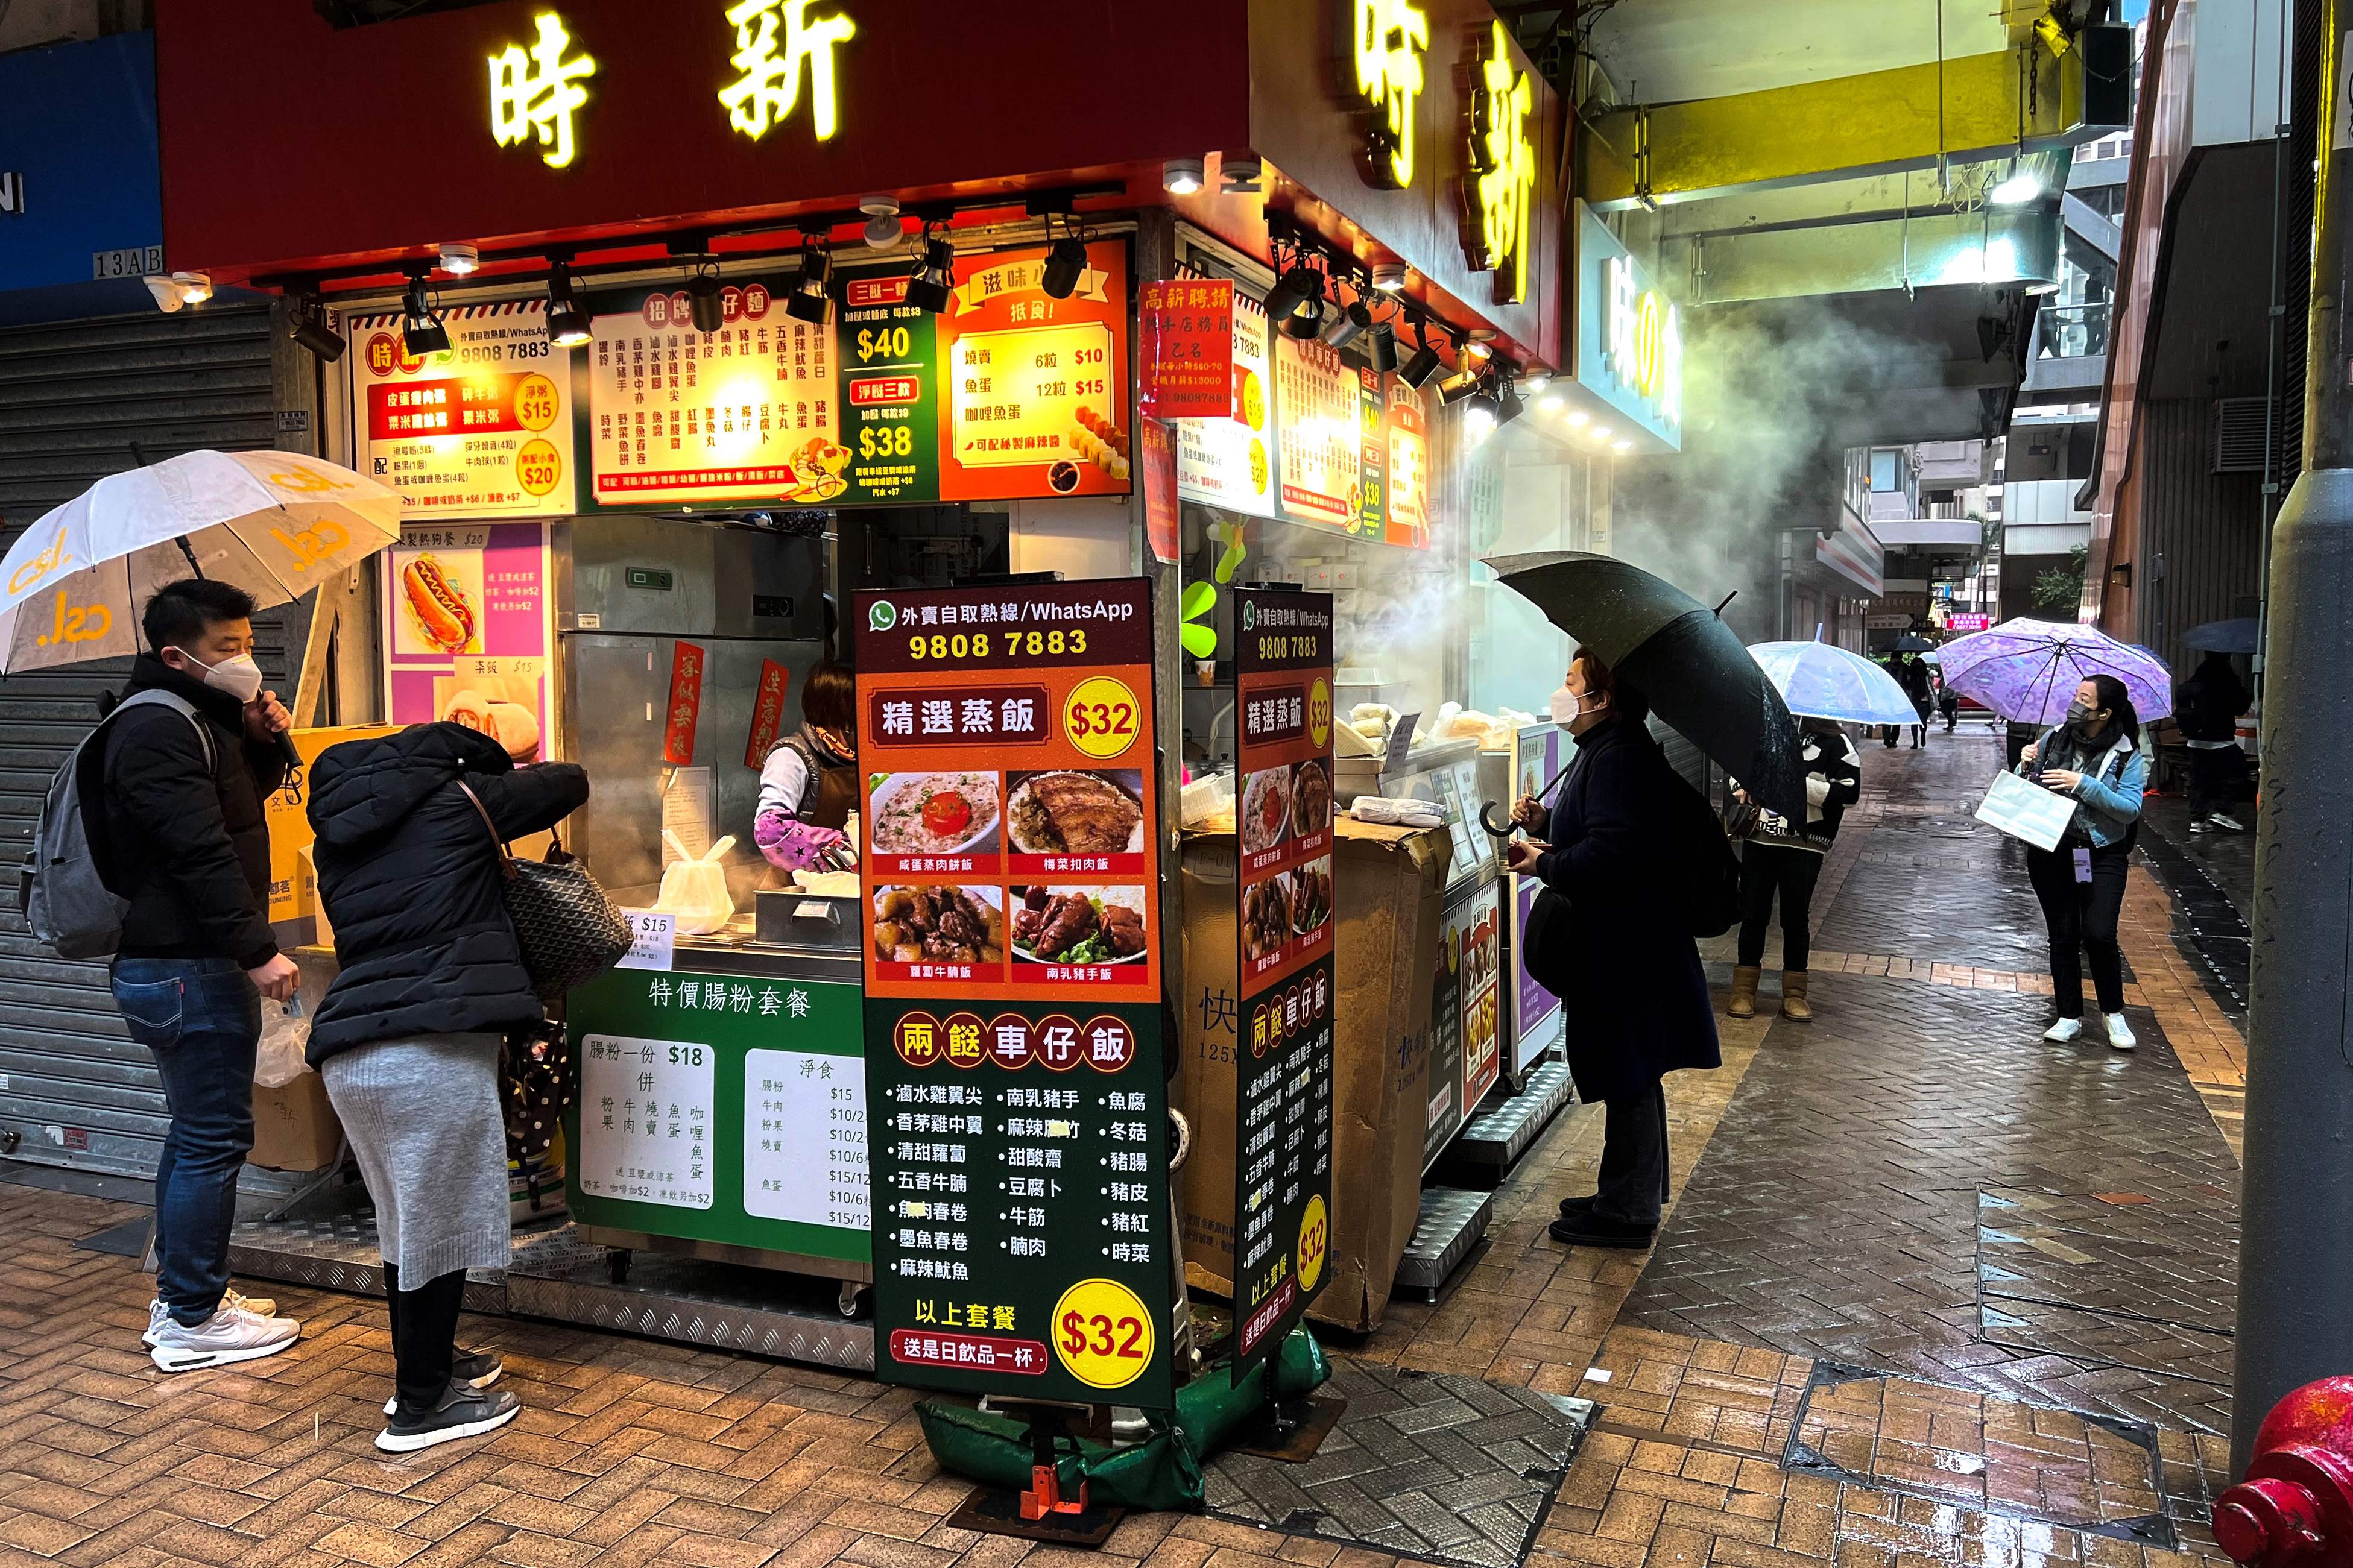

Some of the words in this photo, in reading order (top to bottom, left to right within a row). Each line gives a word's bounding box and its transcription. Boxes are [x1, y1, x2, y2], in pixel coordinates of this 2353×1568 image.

[95, 248, 161, 278] 13AB
[982, 263, 1047, 295] 滋味
[649, 292, 765, 323] 招牌仔麵
[1145, 287, 1230, 309] 高薪聘請
[461, 346, 502, 363] 9808
[508, 341, 549, 360] 7883
[703, 332, 713, 359] 豬皮
[721, 330, 731, 357] 腩肉
[739, 329, 750, 356] 豬紅
[757, 327, 768, 354] 牛筋
[776, 326, 788, 381] 五香牛腩
[794, 324, 806, 380] 麻辣魷魚
[857, 327, 909, 362] $40
[1172, 342, 1202, 359] 乙名
[1239, 336, 1260, 359] 7883
[615, 340, 627, 392] 南乳豬手
[964, 348, 991, 366] 燒賣
[1035, 352, 1057, 368] 6粒
[1075, 348, 1103, 365] $10
[526, 385, 548, 398] 淨粥
[965, 377, 992, 394] 魚蛋
[1036, 380, 1067, 397] 12粒
[1075, 379, 1104, 396] $15
[463, 409, 499, 426] 粟米粥
[523, 401, 551, 421] $15
[652, 411, 662, 437] 魚腐
[760, 404, 770, 444] 豆腐卜
[778, 403, 789, 429] 牛丸
[797, 401, 807, 429] 魚蛋
[815, 400, 826, 427] 豬腸
[1365, 403, 1380, 432] $40
[601, 415, 611, 440] 時菜
[859, 426, 912, 461] $38
[374, 457, 388, 475] 配
[394, 459, 427, 471] 粉果(1個)
[466, 455, 508, 467] 牛肉球(1粒)
[1251, 466, 1264, 485] $20
[270, 464, 355, 492] csl.
[525, 467, 553, 487] $20
[506, 492, 520, 502] +$7
[1365, 479, 1380, 507] $38
[464, 532, 482, 546] $20
[7, 527, 72, 596] csl.
[901, 600, 1134, 626] 外賣自取熱線/WhatsApp
[1256, 608, 1328, 630] 外賣自取熱線/WhatsApp
[909, 633, 990, 660] 9808
[1005, 629, 1087, 656] 7883
[1259, 635, 1287, 660] 9808
[1291, 635, 1316, 658] 7883
[513, 660, 532, 673] $15
[882, 697, 1035, 735] 精選蒸飯
[1070, 702, 1133, 739] $32
[1248, 696, 1301, 735] 精選蒸飯
[1311, 699, 1328, 732] $32
[899, 858, 973, 872] 咸蛋蒸肉餅飯
[1044, 857, 1109, 871] 梅菜扣肉飯
[642, 916, 667, 933] $15
[909, 965, 971, 979] 蘿蔔牛腩飯
[1046, 967, 1113, 981] 南乳豬手飯
[648, 978, 812, 1019] 特價腸粉套餐
[1199, 986, 1236, 1034] 快
[1254, 978, 1325, 1051] 兩餸車仔飯
[589, 1041, 656, 1065] 腸粉一份
[669, 1045, 703, 1068] $18
[902, 1022, 1126, 1063] 兩餸車仔飯
[637, 1071, 655, 1092] 併
[800, 1059, 835, 1080] 淨食
[762, 1079, 784, 1093] 腸粉
[831, 1087, 853, 1101] $15
[896, 1083, 983, 1106] 滷水雞翼尖
[1006, 1088, 1079, 1109] 南乳豬手
[1108, 1091, 1146, 1112] 魚腐
[601, 1097, 614, 1131] 粉果
[623, 1097, 636, 1134] 牛肉
[645, 1100, 659, 1137] 燒賣
[667, 1103, 681, 1139] 魚蛋
[762, 1100, 783, 1113] 牛肉
[830, 1108, 868, 1124] $10/2
[762, 1118, 783, 1132] 粉果
[830, 1129, 868, 1144] $10/2
[897, 1113, 983, 1135] 香茅雞中翼
[1110, 1121, 1146, 1142] 冬菇
[762, 1138, 782, 1153] 燒賣
[897, 1141, 966, 1163] 清甜蘿蔔
[1008, 1148, 1062, 1170] 甜酸齋
[1110, 1151, 1148, 1173] 豬腸
[762, 1178, 782, 1192] 魚蛋
[829, 1170, 870, 1186] $15/12
[898, 1171, 967, 1193] 五香牛腩
[1009, 1177, 1063, 1198] 豆腐卜
[1111, 1180, 1148, 1203] 豬皮
[828, 1212, 870, 1227] $15/12
[1009, 1206, 1045, 1227] 牛筋
[1111, 1212, 1149, 1233] 豬紅
[899, 1229, 968, 1252] 墨魚春卷
[1010, 1236, 1046, 1257] 腩肉
[1112, 1242, 1150, 1264] 時菜
[1300, 1218, 1324, 1273] $32
[900, 1258, 969, 1282] 麻辣魷魚
[1251, 1252, 1287, 1308] 以上套餐
[915, 1298, 1015, 1332] 以上套餐
[1245, 1283, 1293, 1348] 送是日飲品一杯
[1061, 1309, 1143, 1359] $32
[903, 1336, 1033, 1368] 送是日飲品一杯
